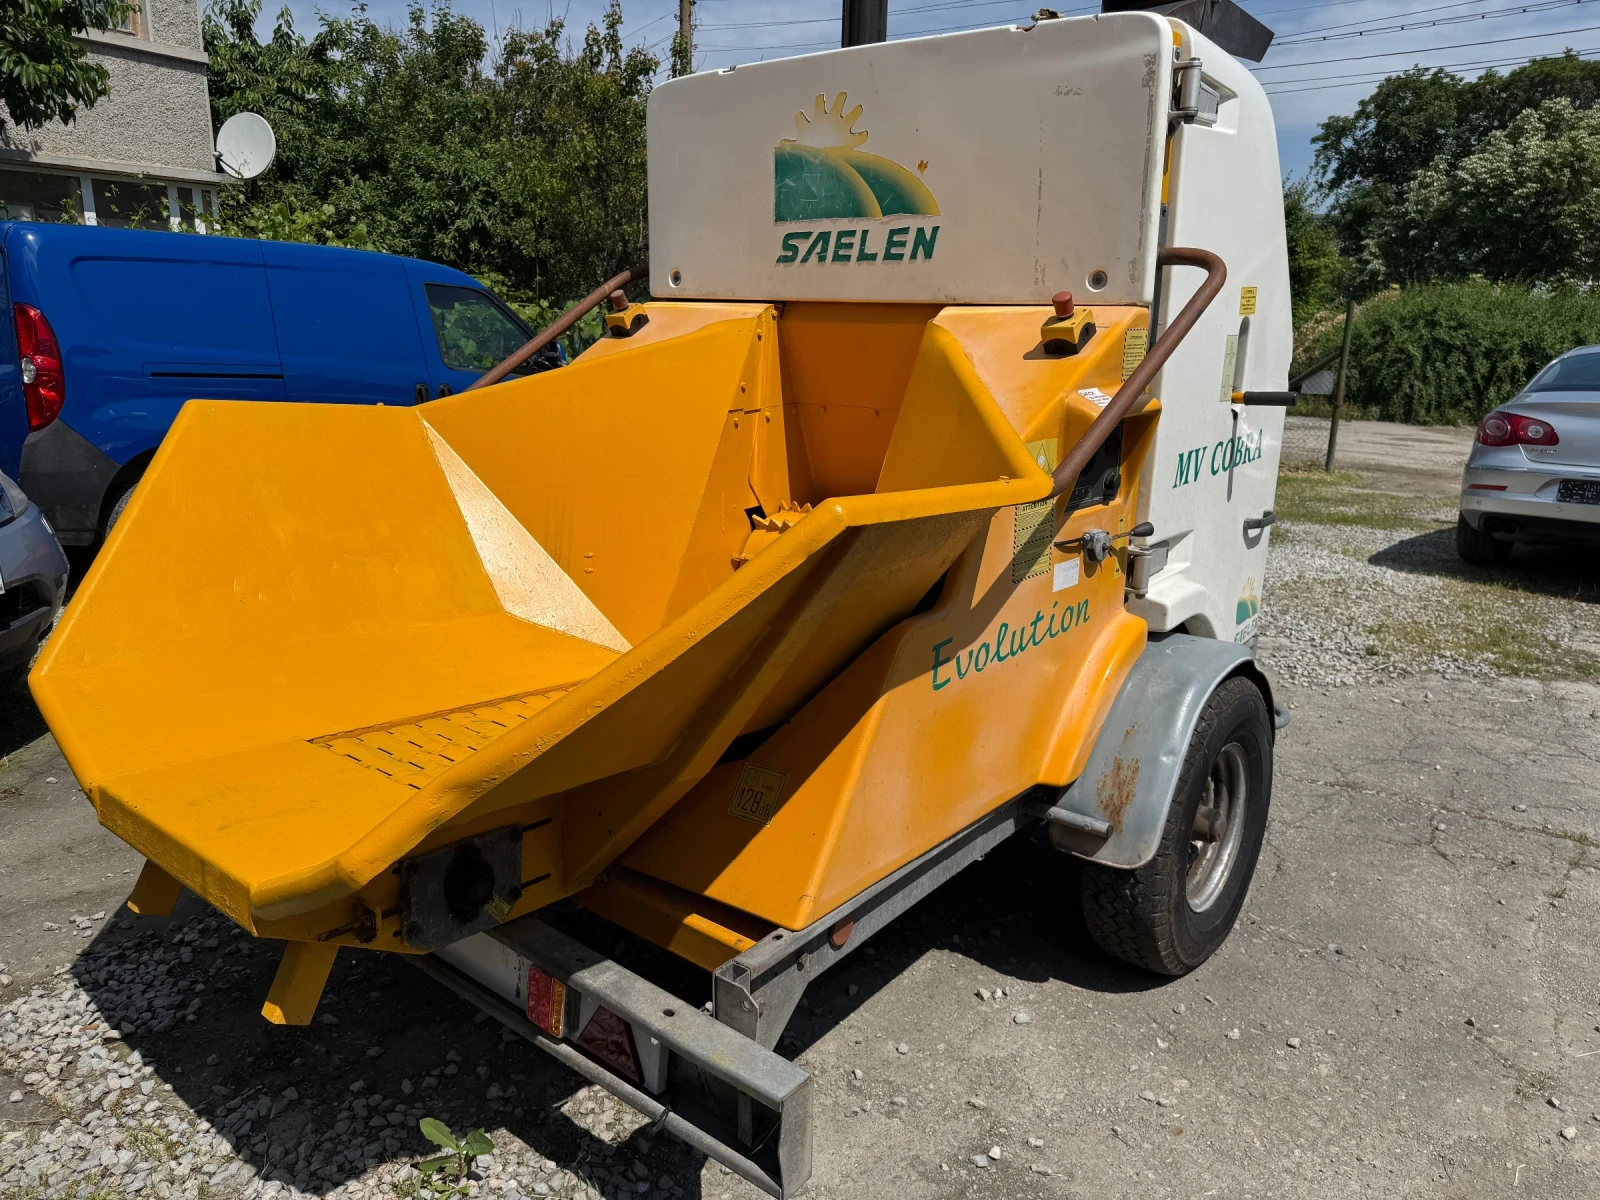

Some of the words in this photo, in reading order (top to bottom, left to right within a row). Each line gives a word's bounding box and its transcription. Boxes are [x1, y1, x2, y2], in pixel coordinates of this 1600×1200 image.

[775, 226, 941, 264] SAELEN
[1172, 446, 1208, 489] MV
[1210, 429, 1263, 476] COBRA
[1022, 500, 1048, 512] ATTENTION
[932, 598, 1091, 691] Evolution
